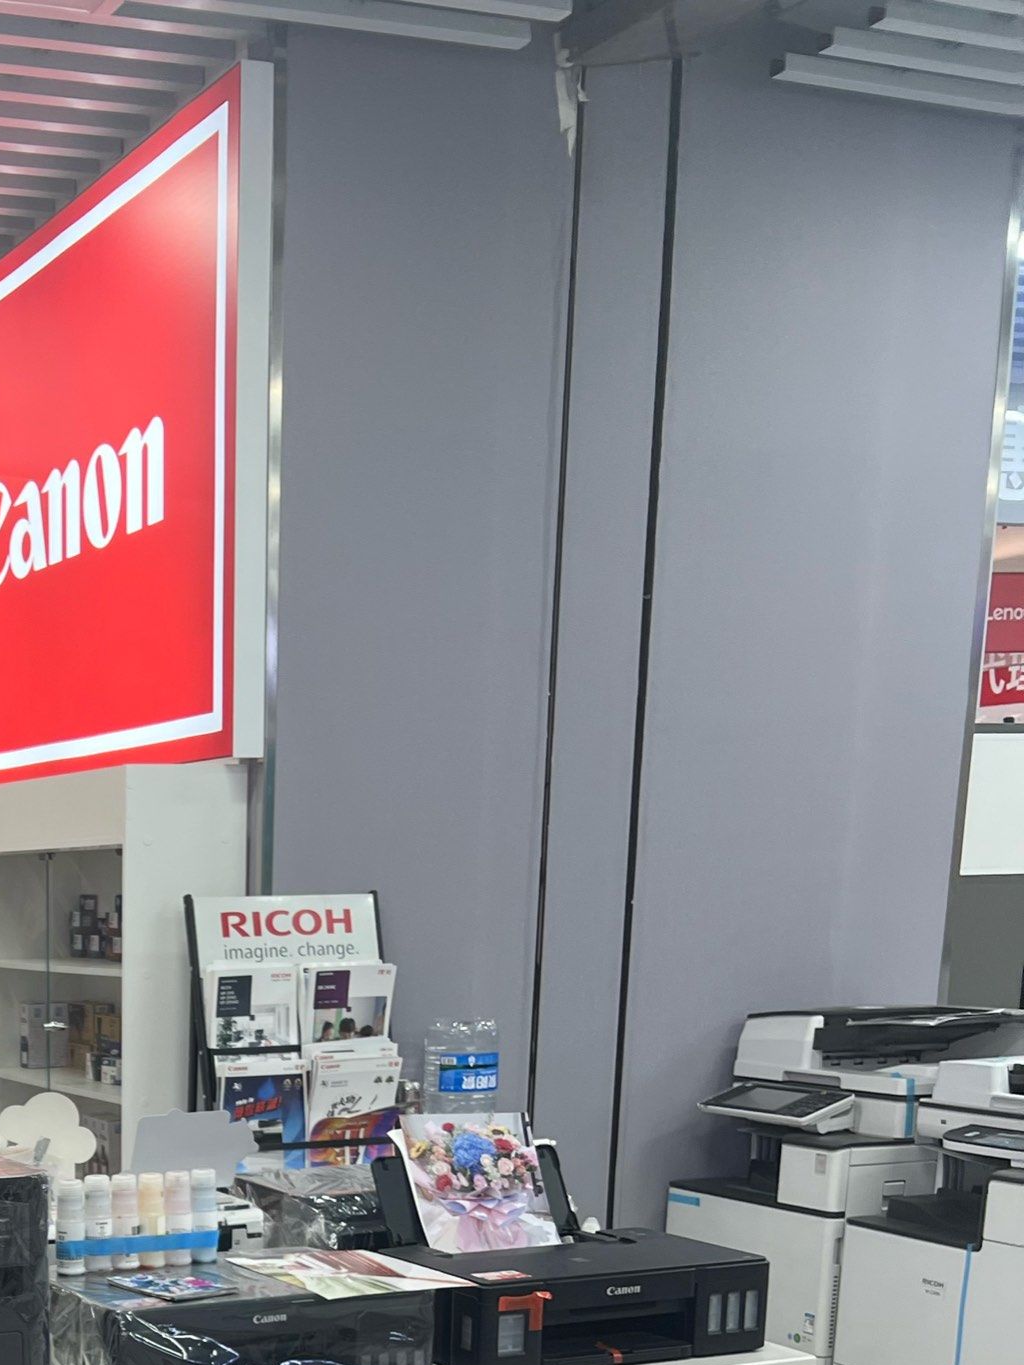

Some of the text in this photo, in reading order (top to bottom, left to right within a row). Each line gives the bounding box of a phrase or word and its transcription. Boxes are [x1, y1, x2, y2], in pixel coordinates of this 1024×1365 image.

[220, 908, 353, 938] RICOH
[224, 941, 360, 962] imagine. change.
[922, 1278, 944, 1289] RICOH
[606, 1285, 641, 1296] Canon
[252, 1314, 287, 1324] Canon
